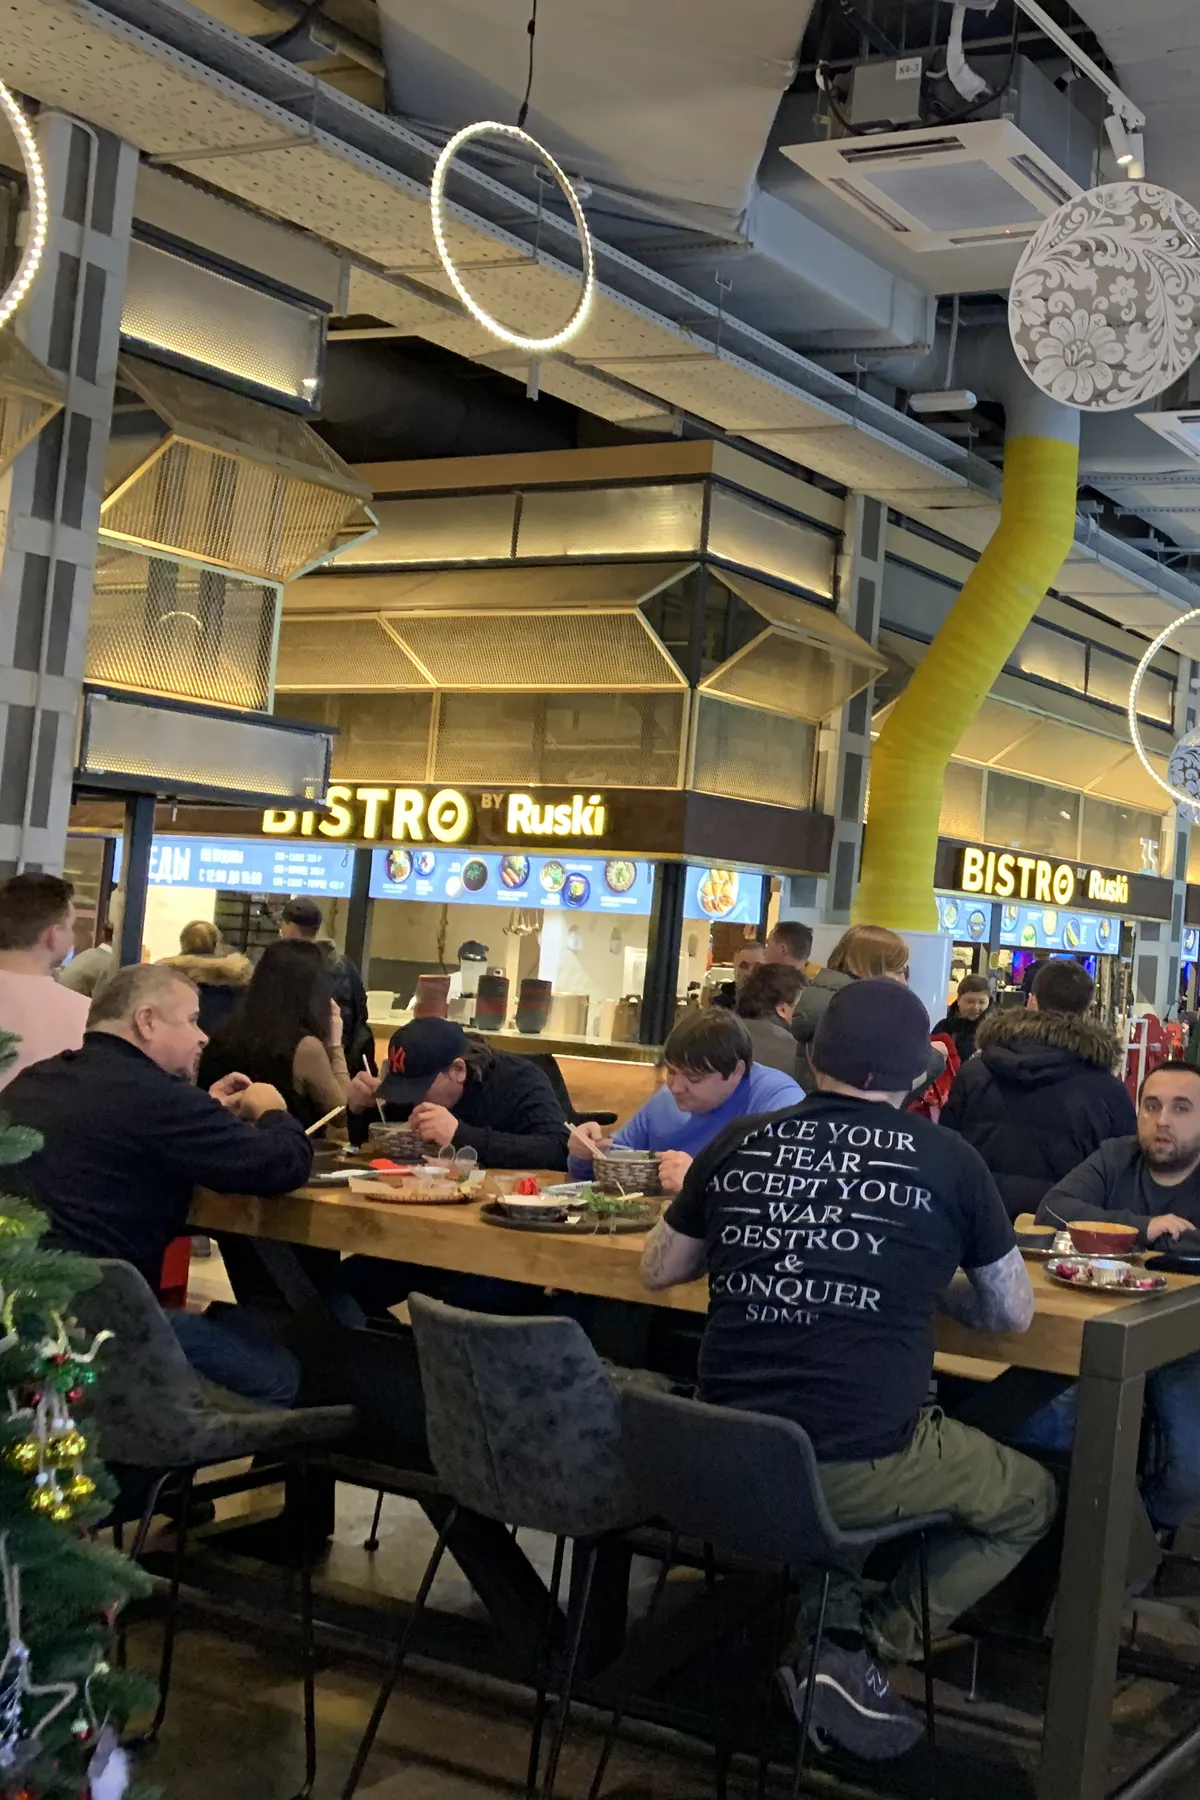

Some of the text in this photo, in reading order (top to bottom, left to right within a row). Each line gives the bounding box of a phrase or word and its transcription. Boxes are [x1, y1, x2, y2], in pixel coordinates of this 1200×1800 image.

[481, 793, 504, 809] BY
[506, 793, 605, 836] Ruski
[149, 846, 192, 884] ЕДЫ
[961, 847, 1074, 905] BISTRO
[1088, 869, 1129, 904] Ruski
[827, 1121, 917, 1152] YOUR
[773, 1143, 862, 1174] FEAR
[705, 1169, 934, 1213] ACCEPT YOUR
[767, 1201, 844, 1225] WAR
[720, 1224, 887, 1256] DESTROY
[774, 1253, 805, 1274] &
[711, 1271, 882, 1313] CONQUER
